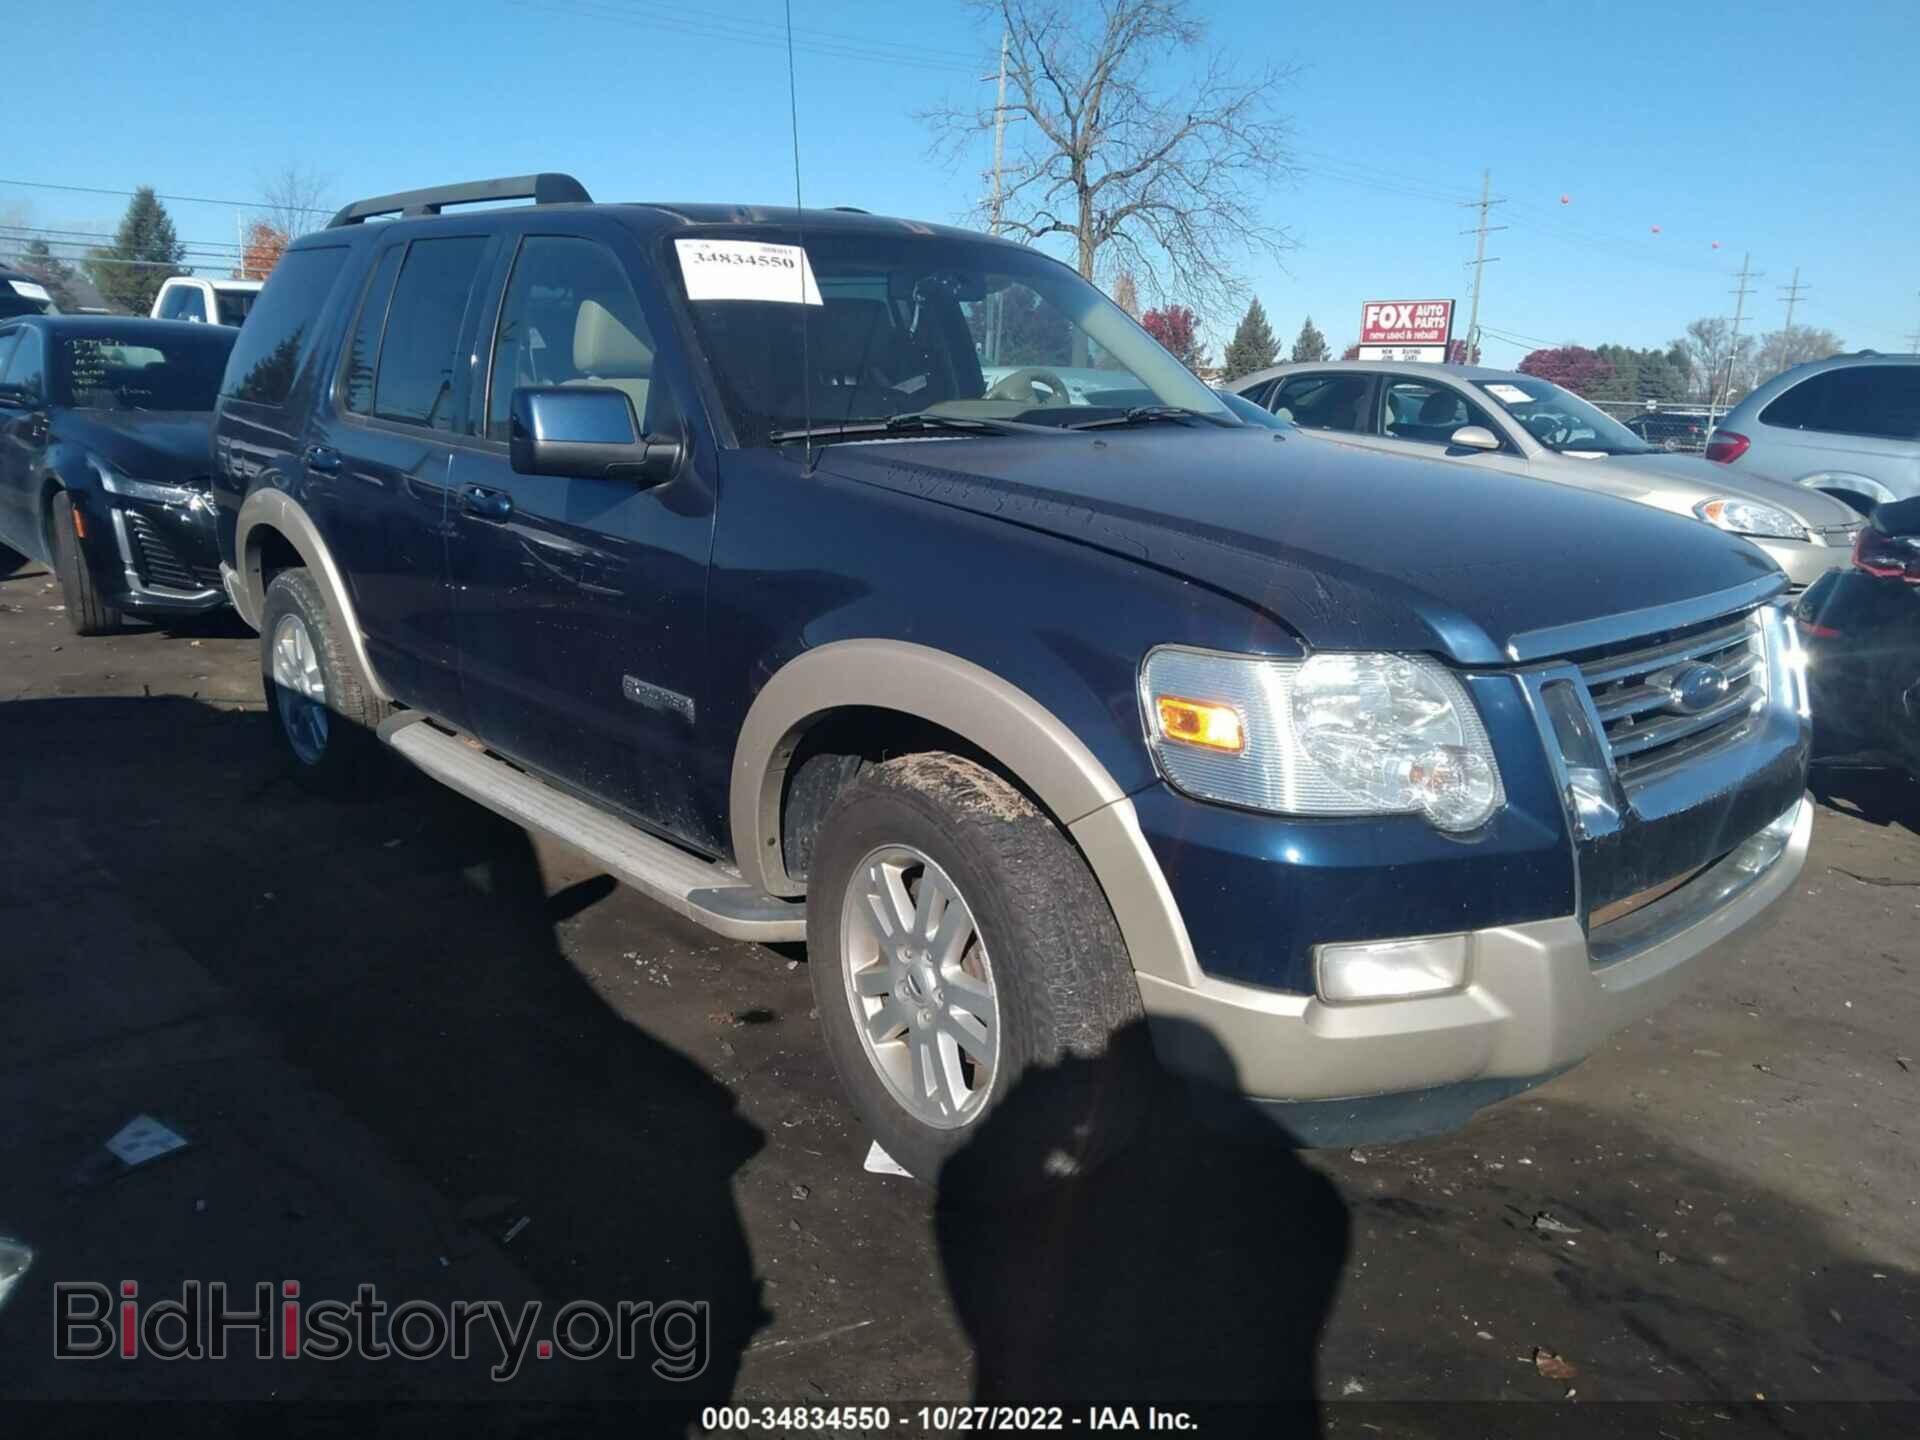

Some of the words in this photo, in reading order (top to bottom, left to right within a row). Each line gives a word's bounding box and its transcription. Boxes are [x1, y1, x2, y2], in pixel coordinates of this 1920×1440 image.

[693, 251, 795, 270] 34834550
[1365, 305, 1415, 330] FOX
[1416, 304, 1444, 316] AUTO
[1414, 317, 1446, 329] PARTS
